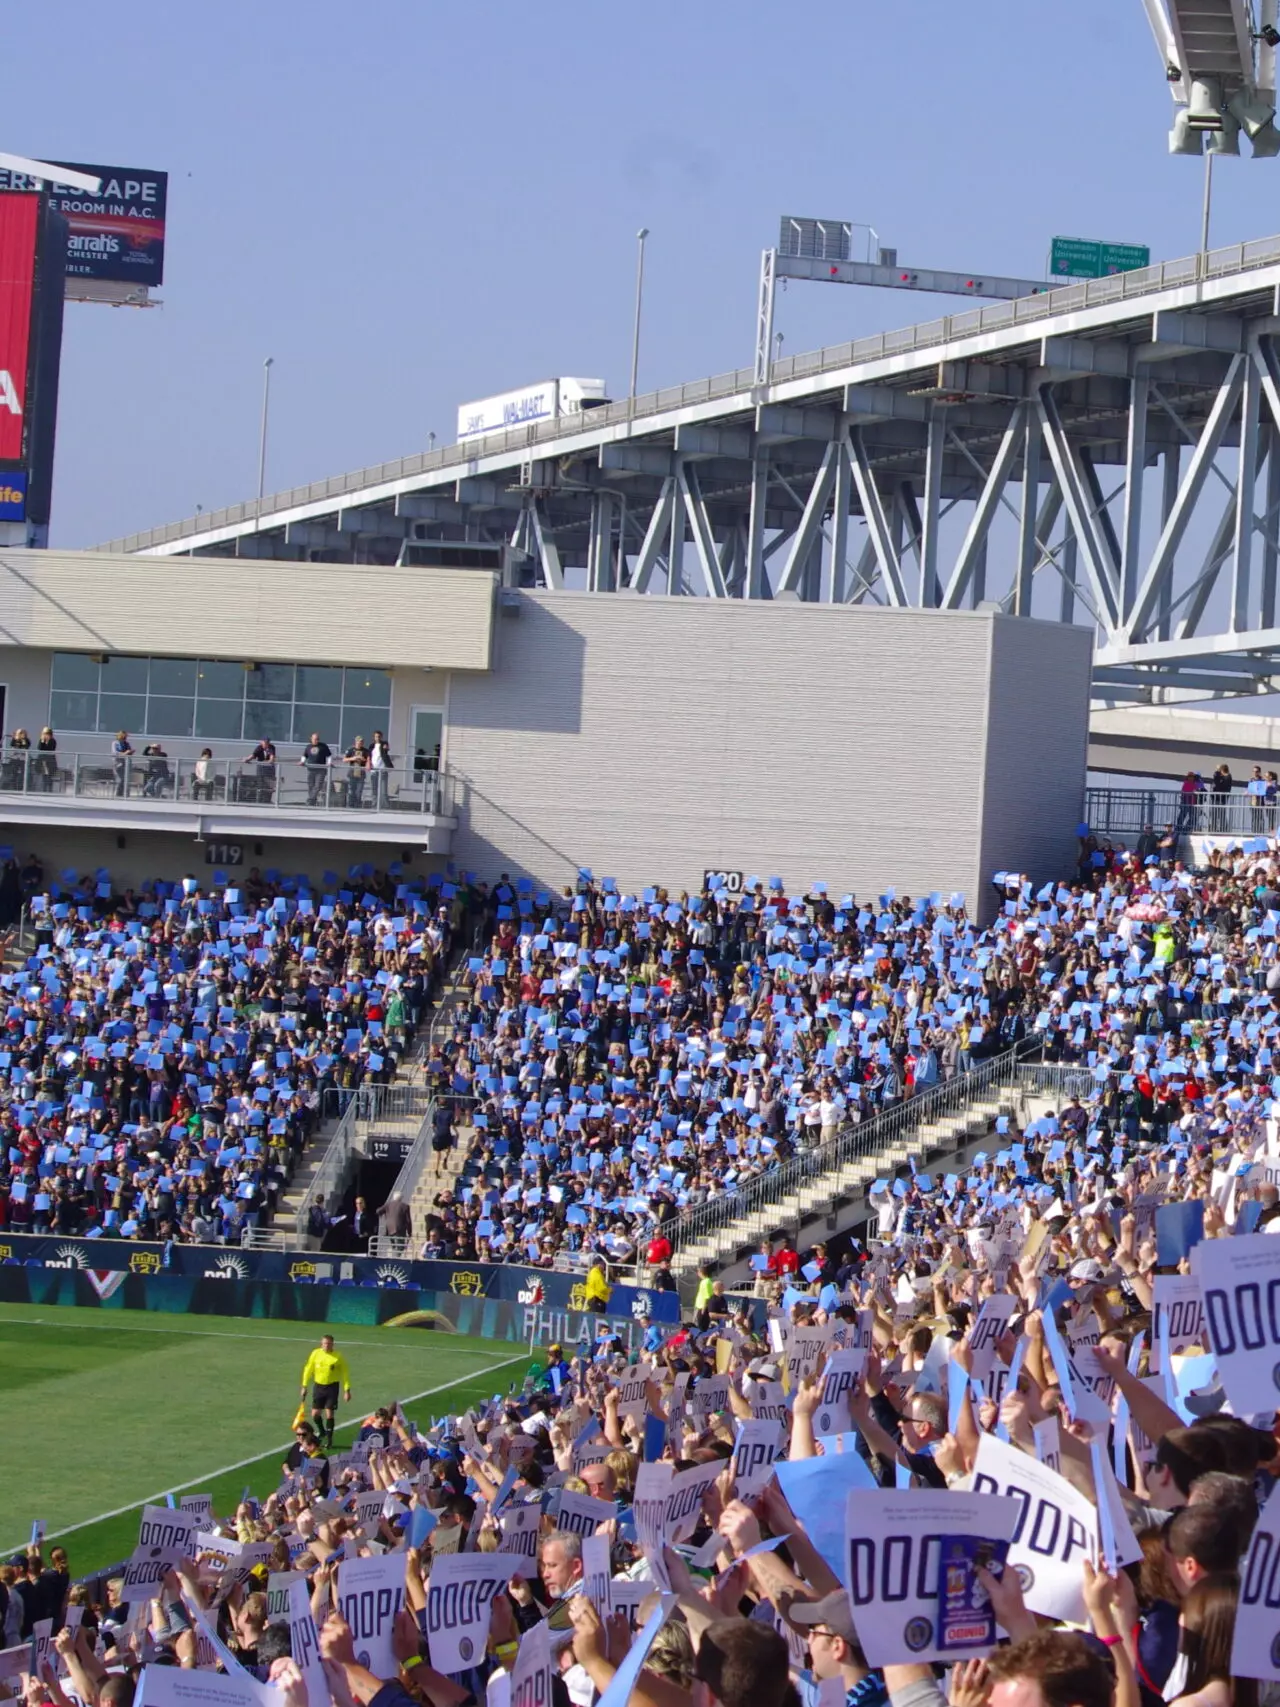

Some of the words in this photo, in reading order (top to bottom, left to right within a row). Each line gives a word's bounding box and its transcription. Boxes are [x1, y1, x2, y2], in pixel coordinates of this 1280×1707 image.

[61, 200, 105, 214] ROOM
[109, 204, 124, 217] IN
[128, 206, 156, 219] A.C.
[67, 234, 119, 252] arrah's
[208, 844, 241, 863] 119
